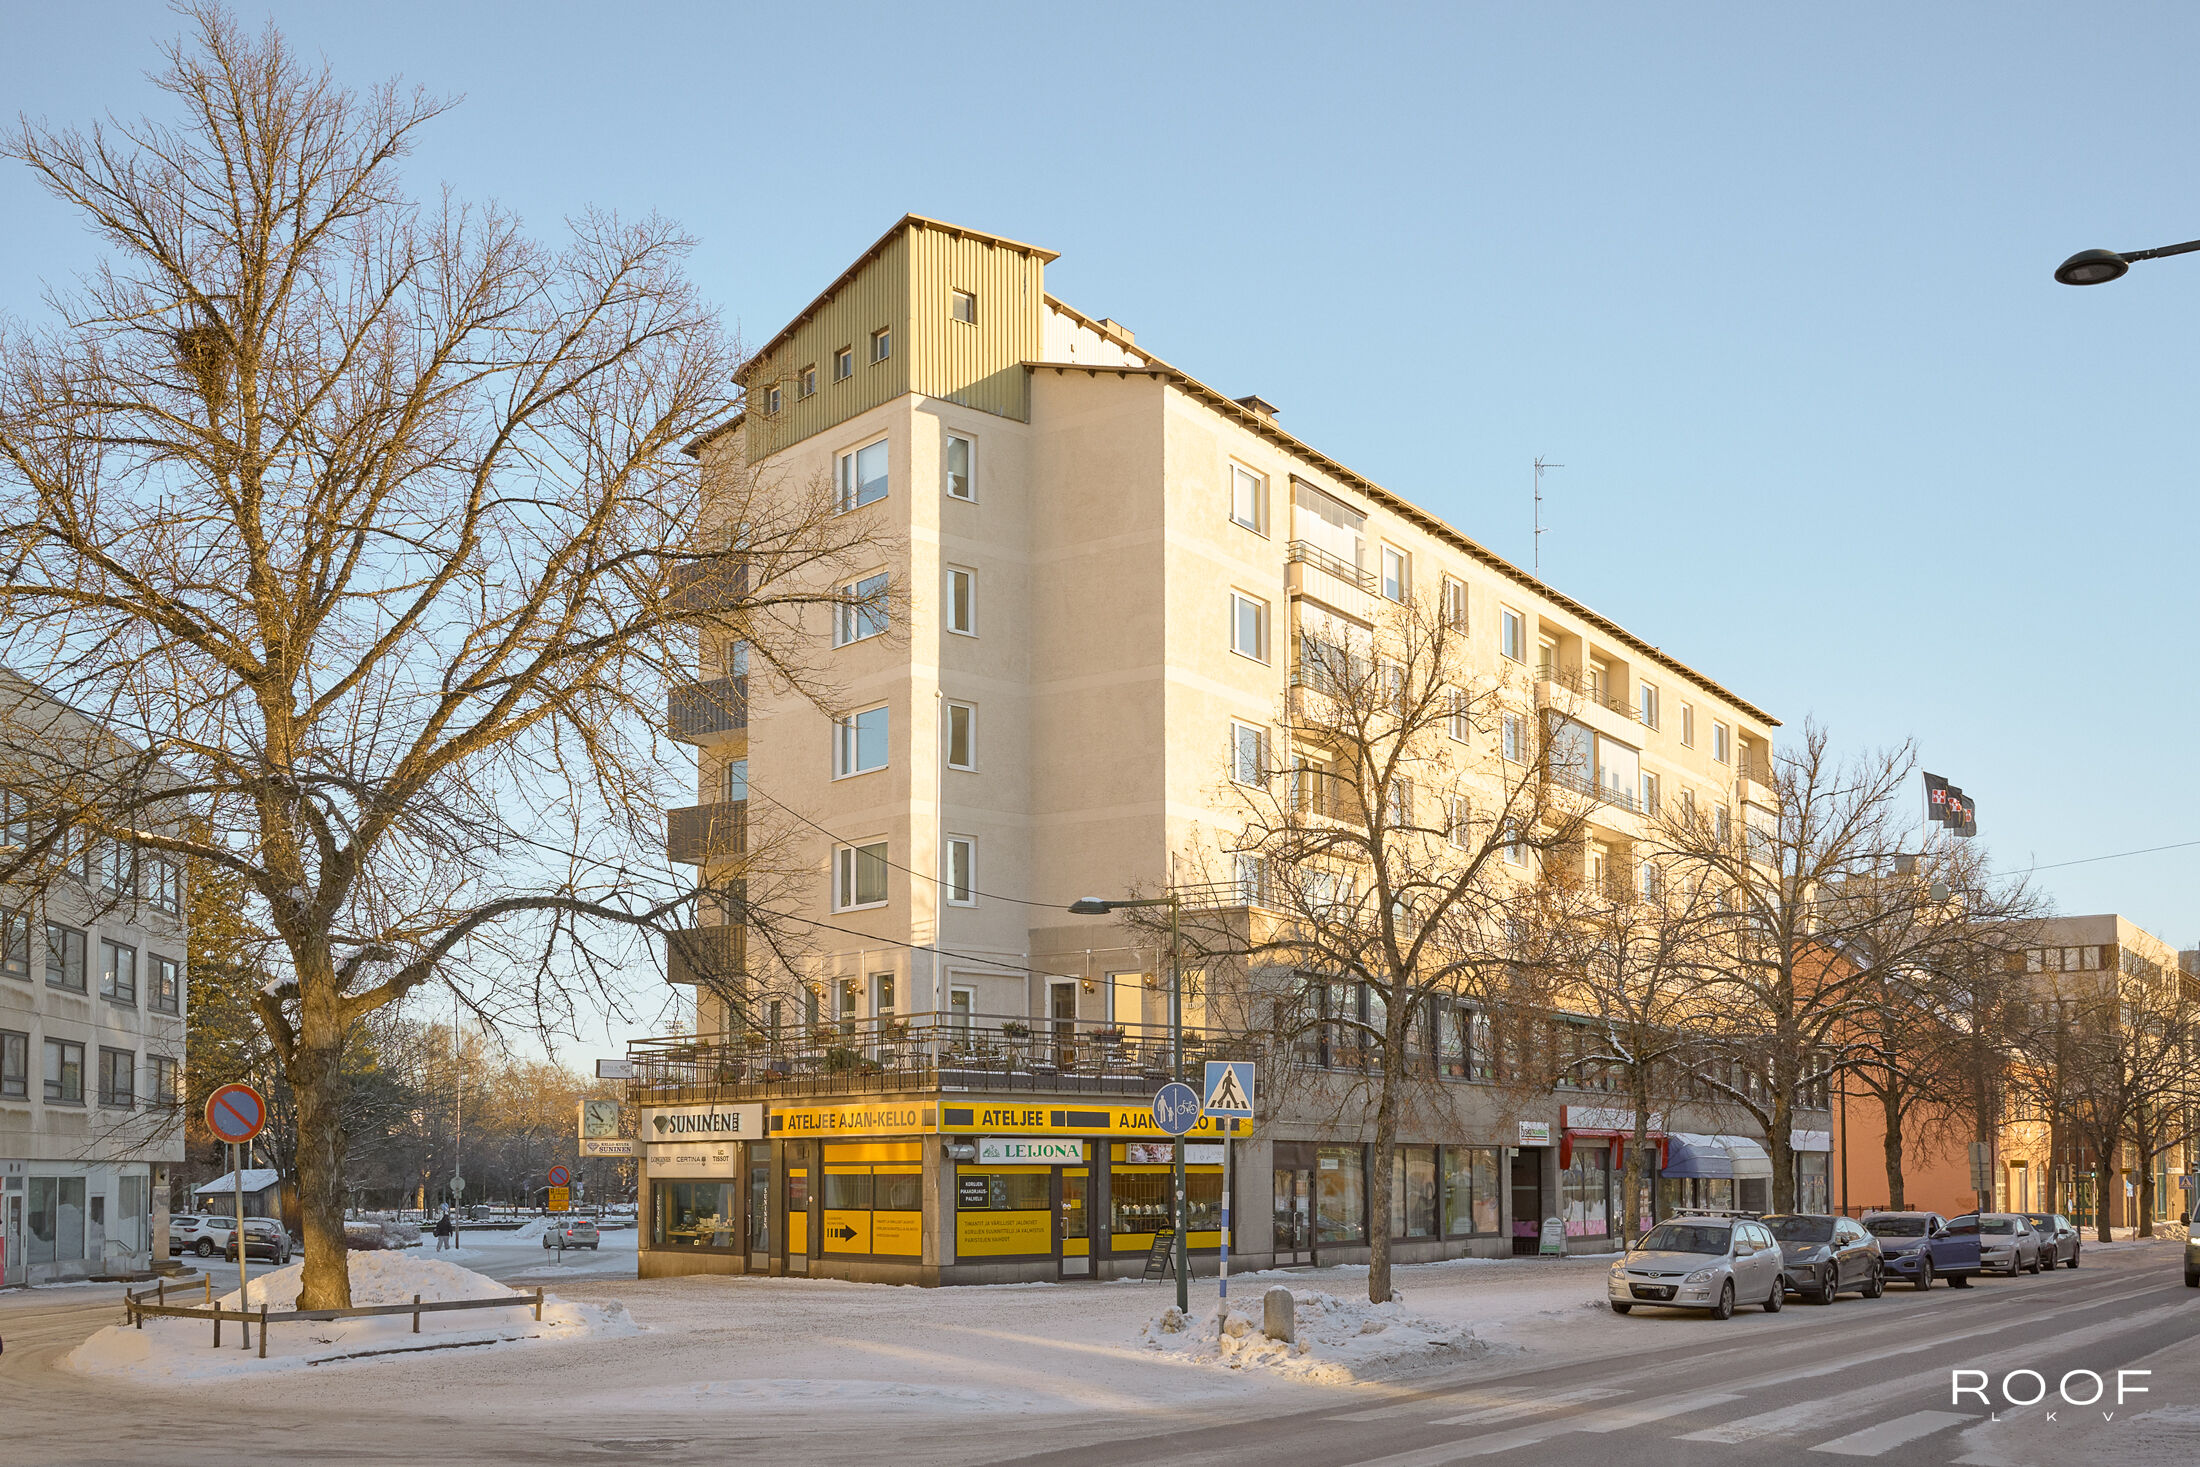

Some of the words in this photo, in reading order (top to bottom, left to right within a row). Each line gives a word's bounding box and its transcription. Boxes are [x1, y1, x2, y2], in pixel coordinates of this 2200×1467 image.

[669, 1113, 732, 1134] SUNINEN
[788, 1114, 836, 1130] ATELJEE
[839, 1110, 917, 1128] AJAN-KELLO
[982, 1110, 1043, 1126] ATELJEE
[1004, 1144, 1080, 1158] LEIJONA
